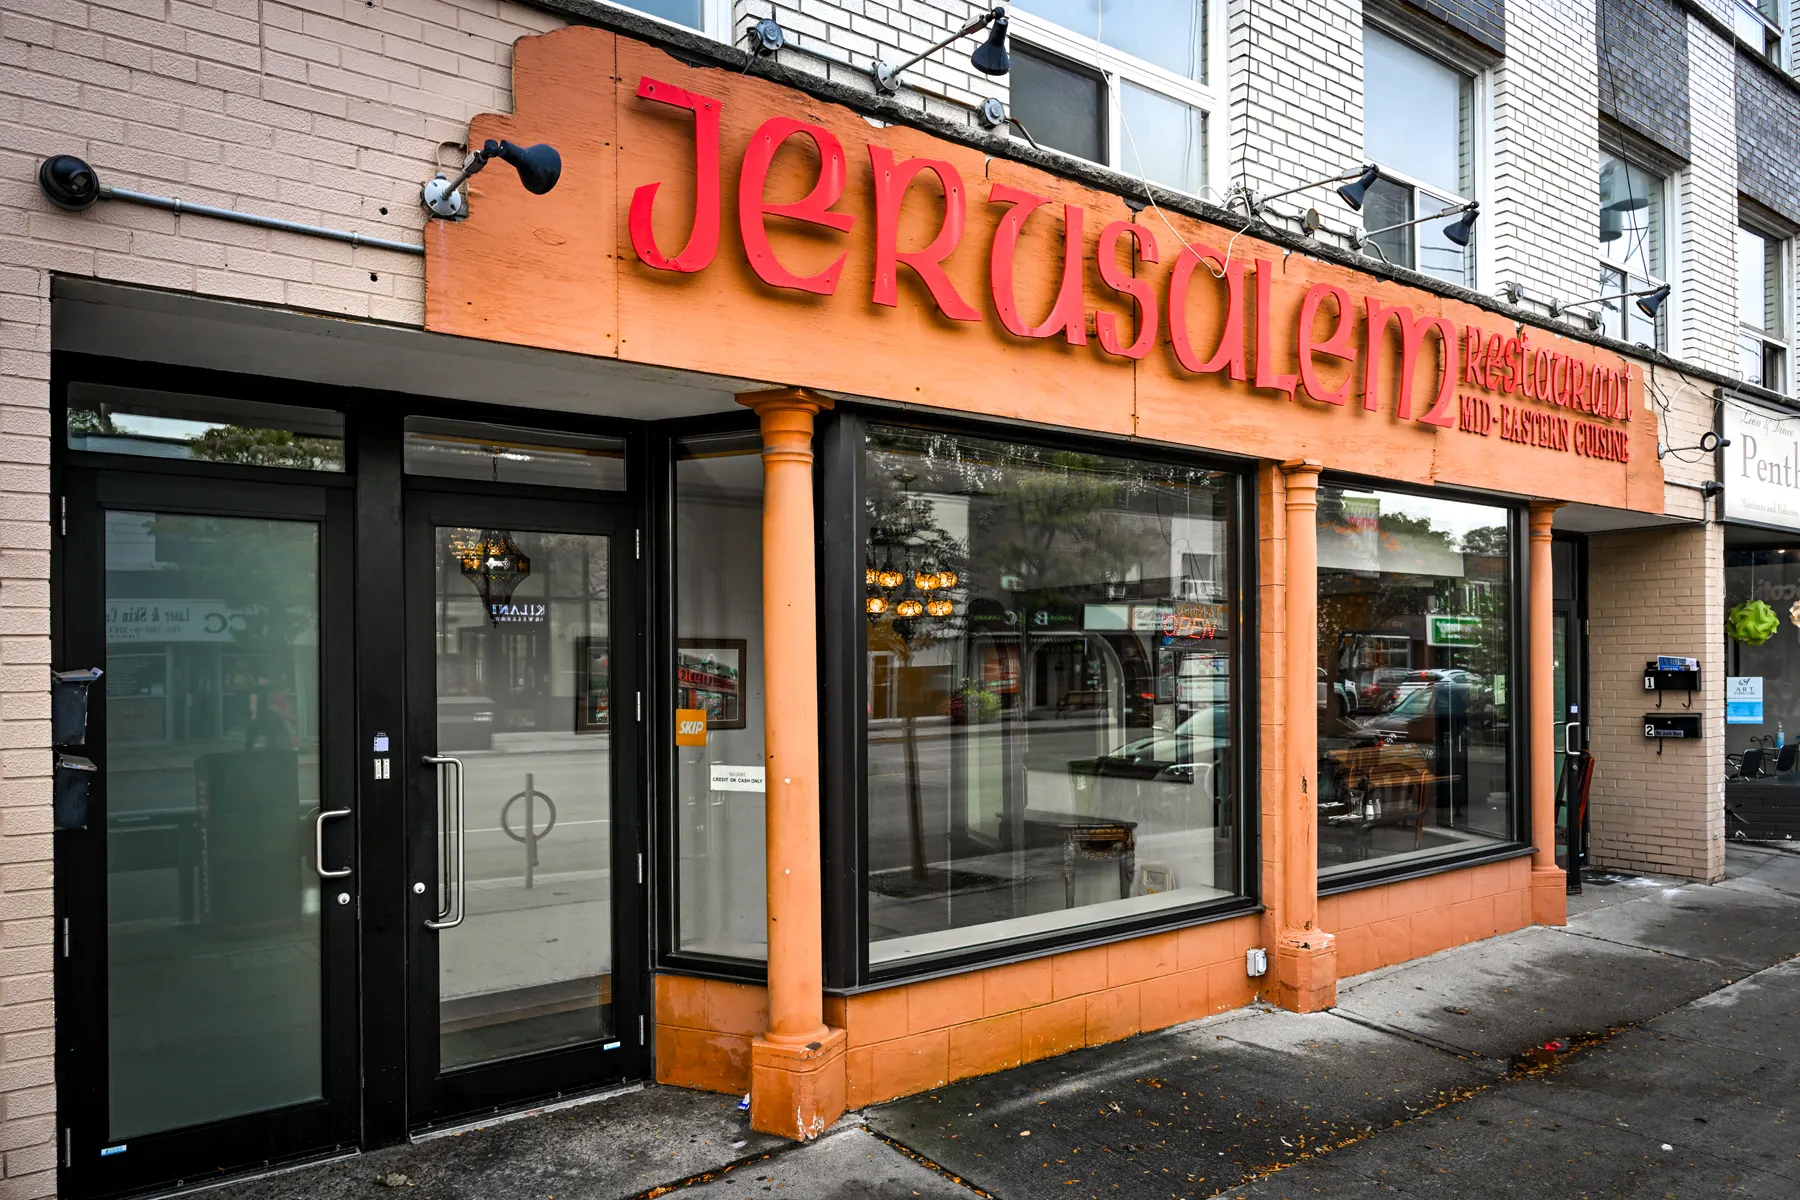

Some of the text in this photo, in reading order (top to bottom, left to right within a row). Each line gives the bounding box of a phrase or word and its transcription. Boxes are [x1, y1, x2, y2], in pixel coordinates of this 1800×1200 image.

[1574, 421, 1629, 463] CUISINE
[1164, 615, 1217, 640] OPEN
[1646, 678, 1653, 688] 1
[679, 721, 704, 735] SKIP
[1646, 725, 1654, 736] 2
